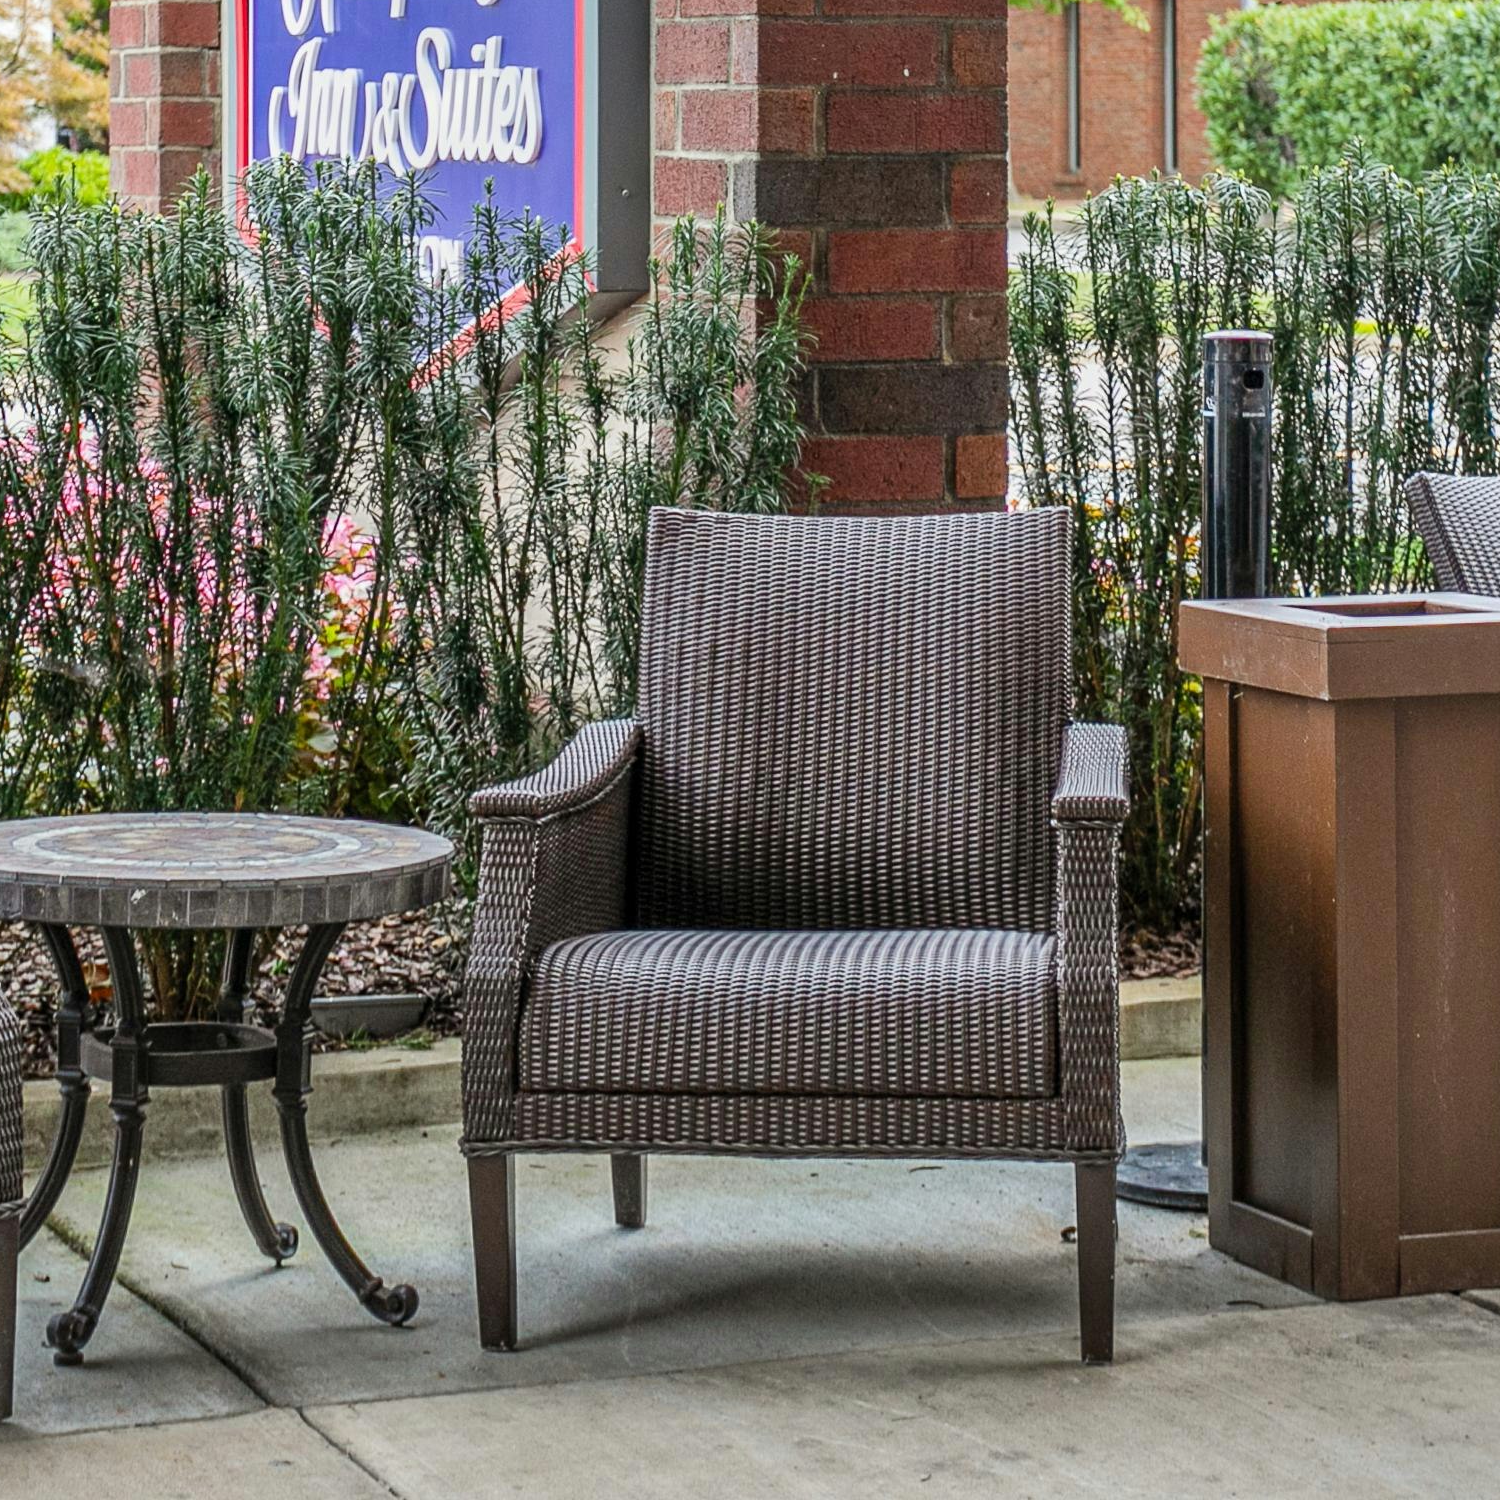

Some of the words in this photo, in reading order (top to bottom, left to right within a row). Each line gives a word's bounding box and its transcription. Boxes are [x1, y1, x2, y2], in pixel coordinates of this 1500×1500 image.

[268, 37, 377, 172] Inn
[372, 72, 406, 178] &
[398, 27, 543, 170] Suites
